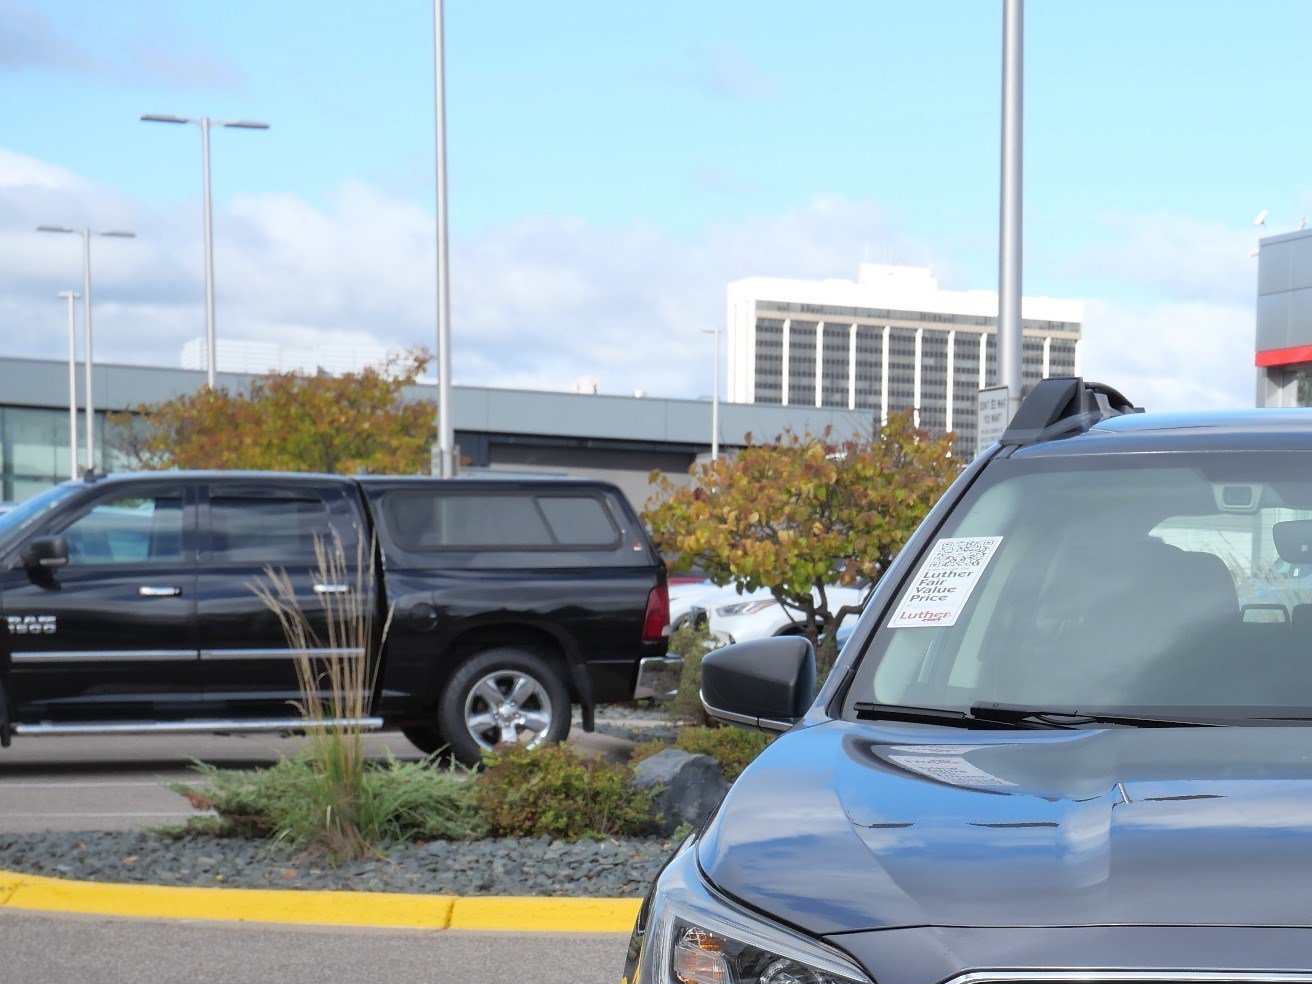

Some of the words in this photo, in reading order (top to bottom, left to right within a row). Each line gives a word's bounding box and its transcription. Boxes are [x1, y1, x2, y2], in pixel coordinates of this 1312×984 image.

[923, 570, 973, 579] Luther
[918, 578, 947, 586] Fair
[915, 586, 957, 594] Value
[909, 594, 949, 602] Price
[899, 610, 951, 620] Luther
